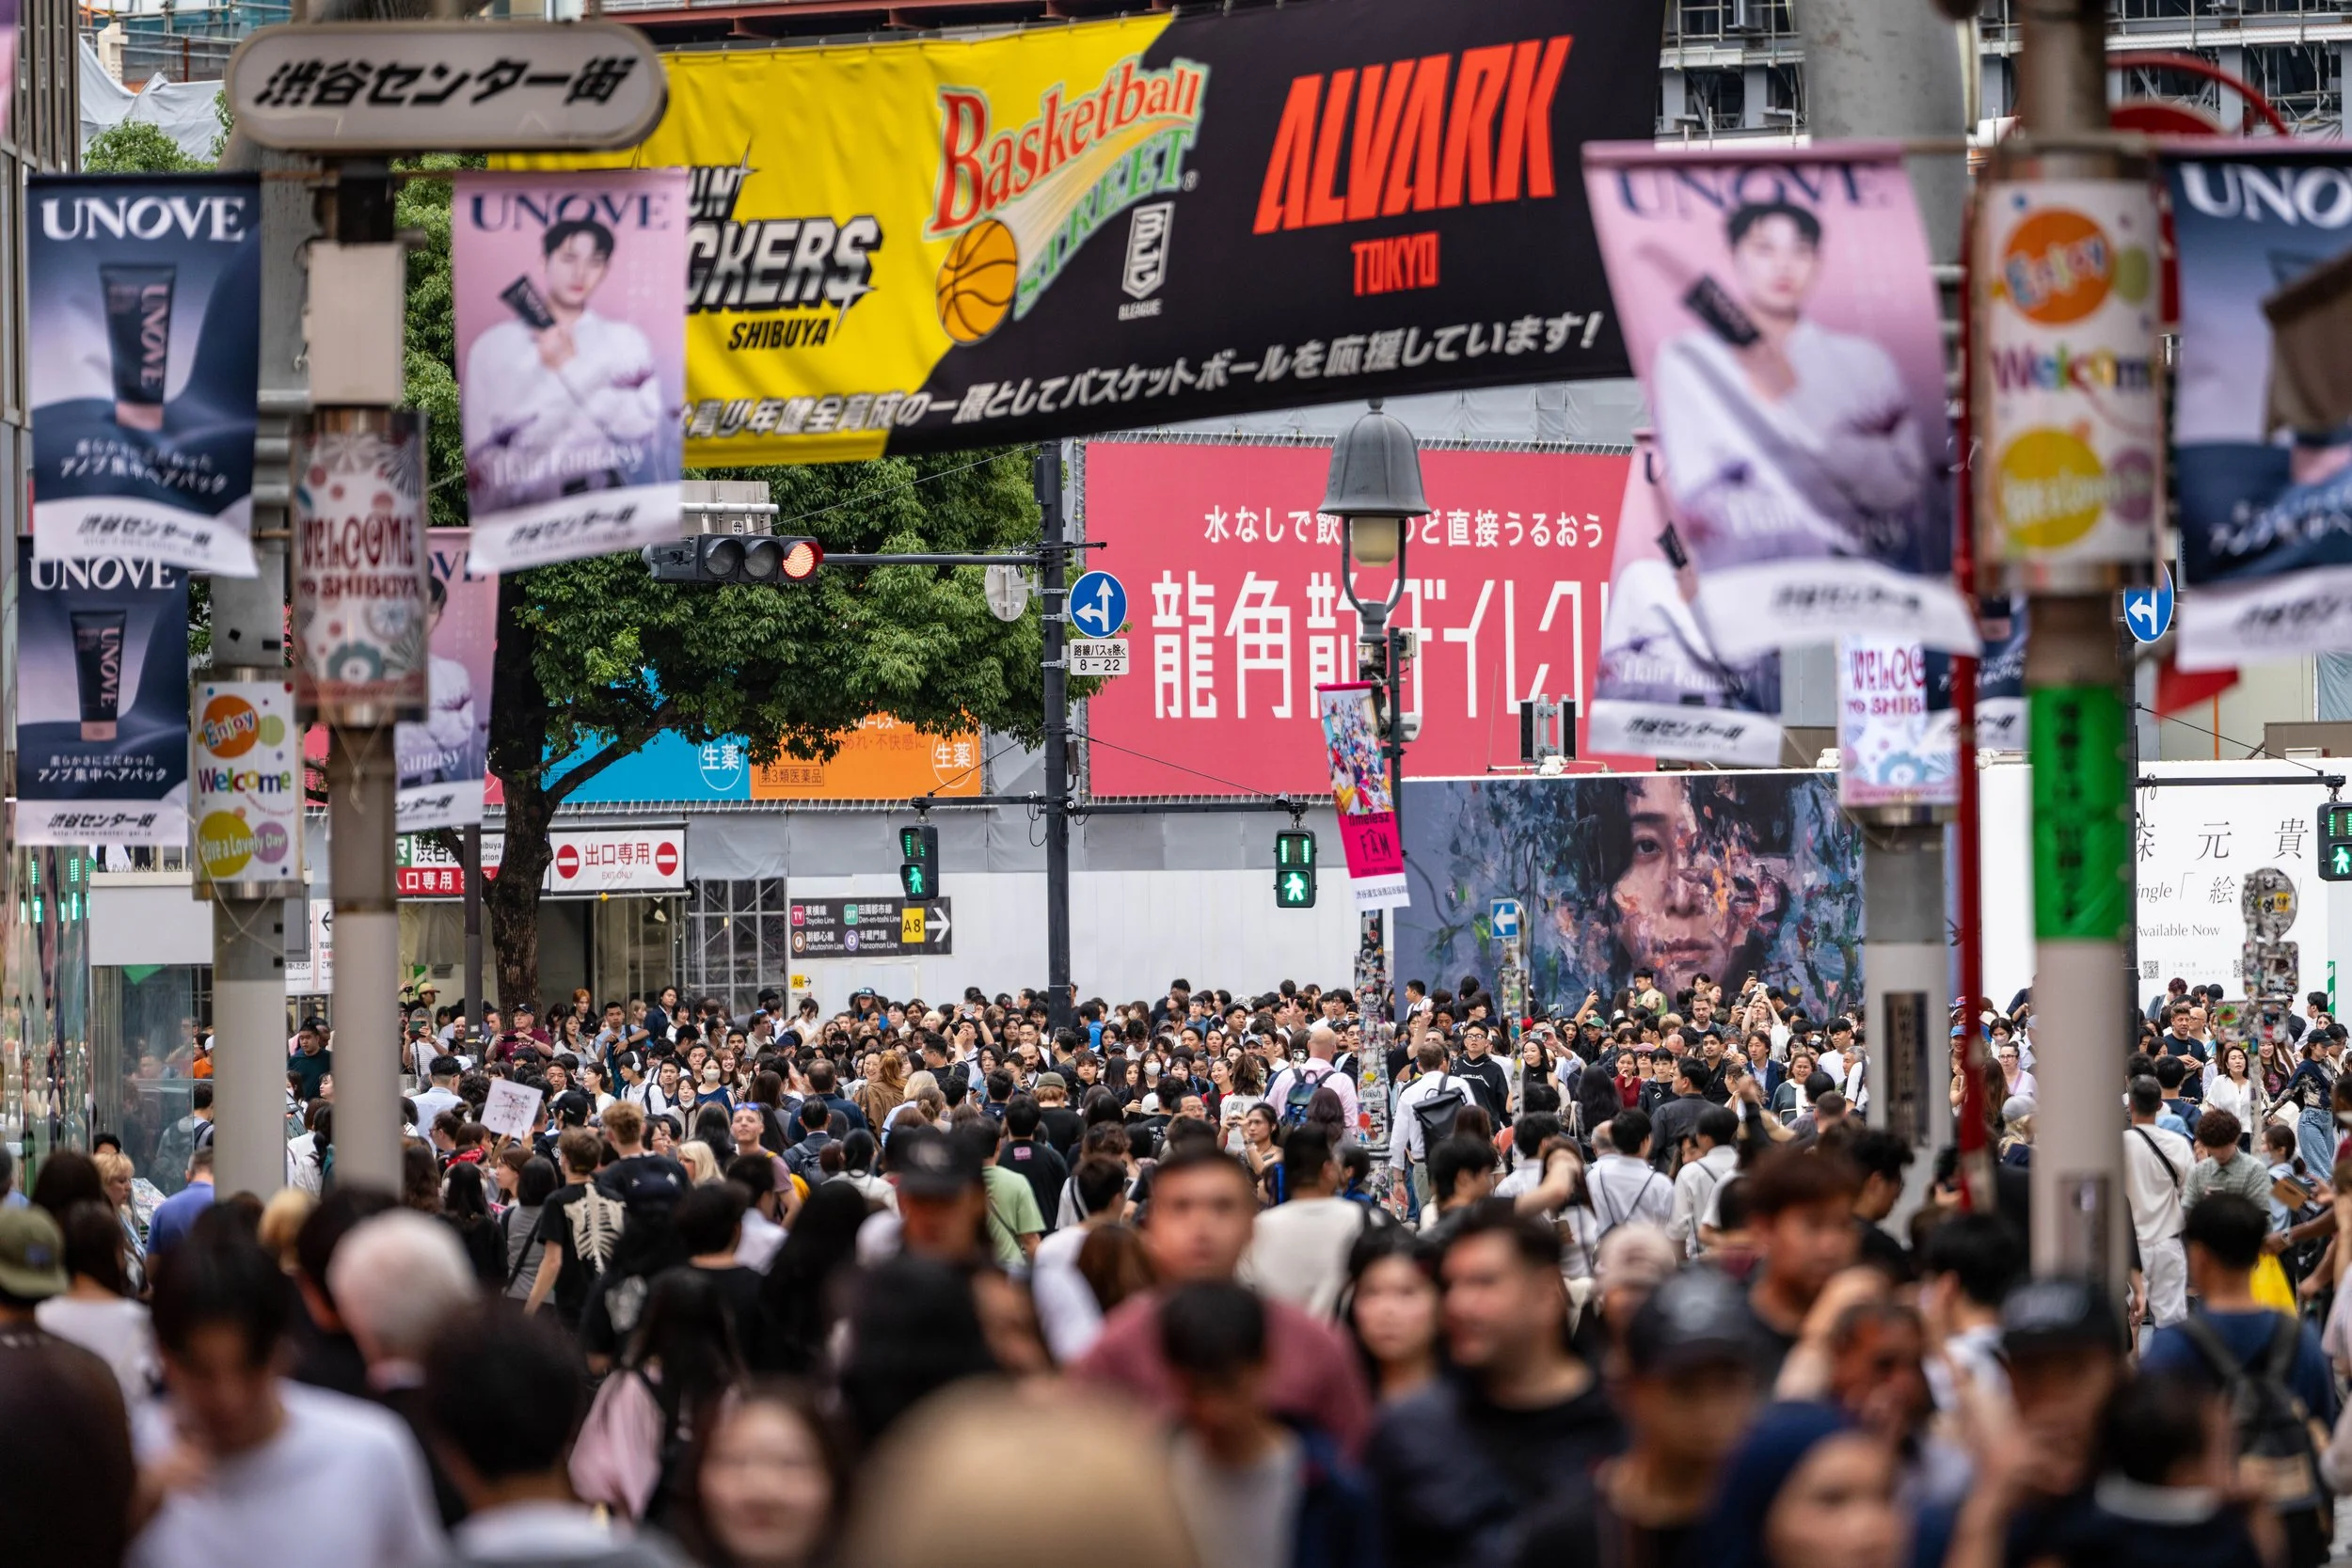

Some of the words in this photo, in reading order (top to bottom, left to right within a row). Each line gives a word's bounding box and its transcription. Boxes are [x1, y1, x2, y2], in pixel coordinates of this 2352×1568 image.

[254, 55, 640, 107] 渋谷センター街
[927, 58, 1204, 235] Basketball
[1252, 35, 1572, 234] ALVARK
[688, 166, 740, 217] UN
[2180, 162, 2352, 230] UNO
[41, 197, 246, 242] UNOVE
[471, 193, 670, 231] UNOVE
[688, 215, 882, 312] CKERS
[1351, 230, 1439, 296] TOKYO
[140, 285, 168, 388] UNOVE
[727, 318, 831, 351] SHIBUYA
[299, 515, 414, 570] WELCOME
[29, 555, 176, 591] UNOVE
[1074, 644, 1126, 657] 路線バスを除く
[100, 627, 120, 708] UNOVE
[1870, 697, 1923, 717] SHIB
[203, 709, 254, 748] Enjoy
[702, 743, 739, 770] 生薬
[935, 741, 971, 768] 生薬
[199, 767, 291, 794] Welcome
[760, 768, 822, 784] 第3類医薬品
[48, 812, 157, 828] 渋谷センター街
[584, 842, 650, 866] 出口専用
[602, 871, 615, 879] EXIT
[617, 871, 633, 879] ONLY
[2137, 882, 2172, 903] ingle
[805, 905, 827, 916] 東横線
[858, 904, 893, 915] 田園都市線
[858, 915, 888, 924] Den-en-toshi
[805, 931, 834, 942] 副都心線
[859, 930, 887, 941] 半蔵門線
[903, 919, 921, 933] A8
[2192, 925, 2220, 937] Now
[793, 978, 803, 987] A8
